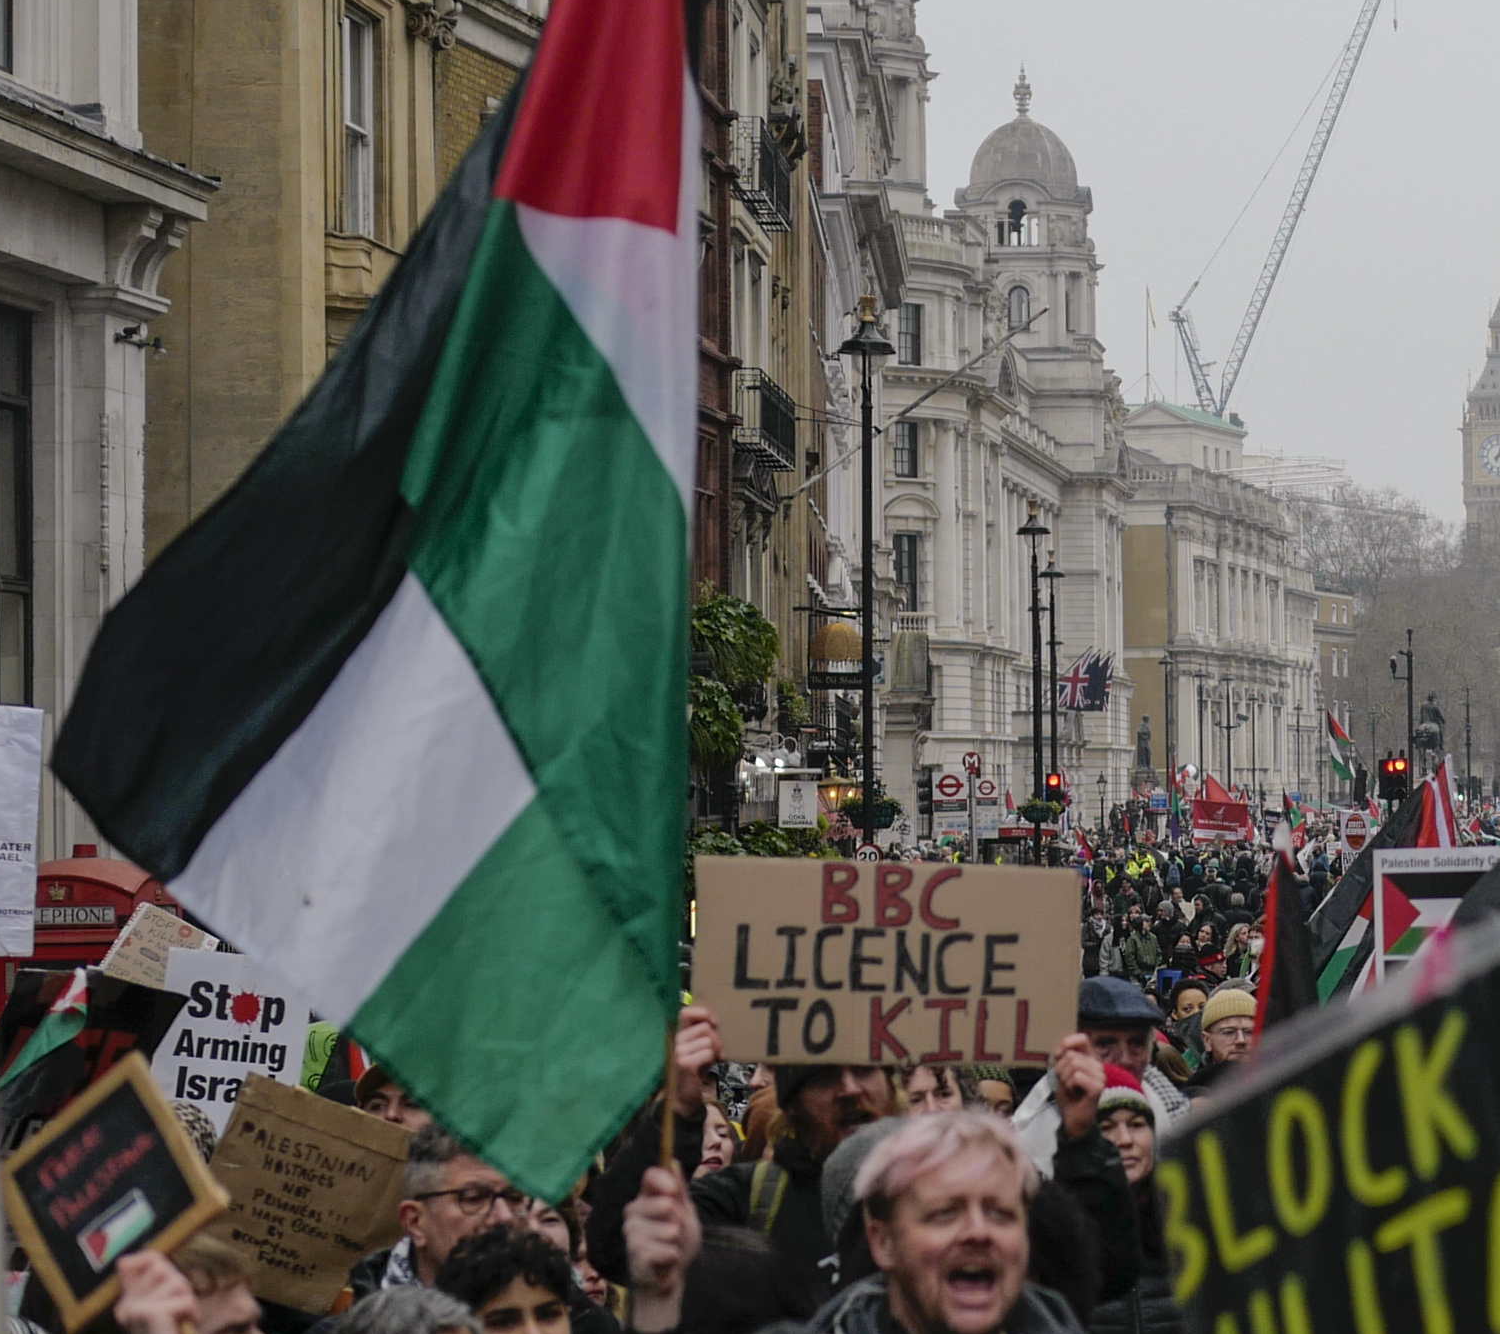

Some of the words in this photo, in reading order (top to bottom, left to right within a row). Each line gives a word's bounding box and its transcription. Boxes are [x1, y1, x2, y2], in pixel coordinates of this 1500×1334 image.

[859, 851, 878, 862] 20
[1381, 857, 1430, 868] Palestine
[1433, 855, 1486, 870] Solidarity
[821, 862, 964, 930] BBC
[733, 923, 1020, 997] LICENCE
[172, 1027, 288, 1073] Arming
[750, 997, 836, 1057] TO
[868, 995, 1050, 1064] KILL
[239, 1120, 376, 1183] PALESTINIAN
[1156, 1008, 1479, 1305] BLOCK
[282, 1182, 311, 1199] NOT
